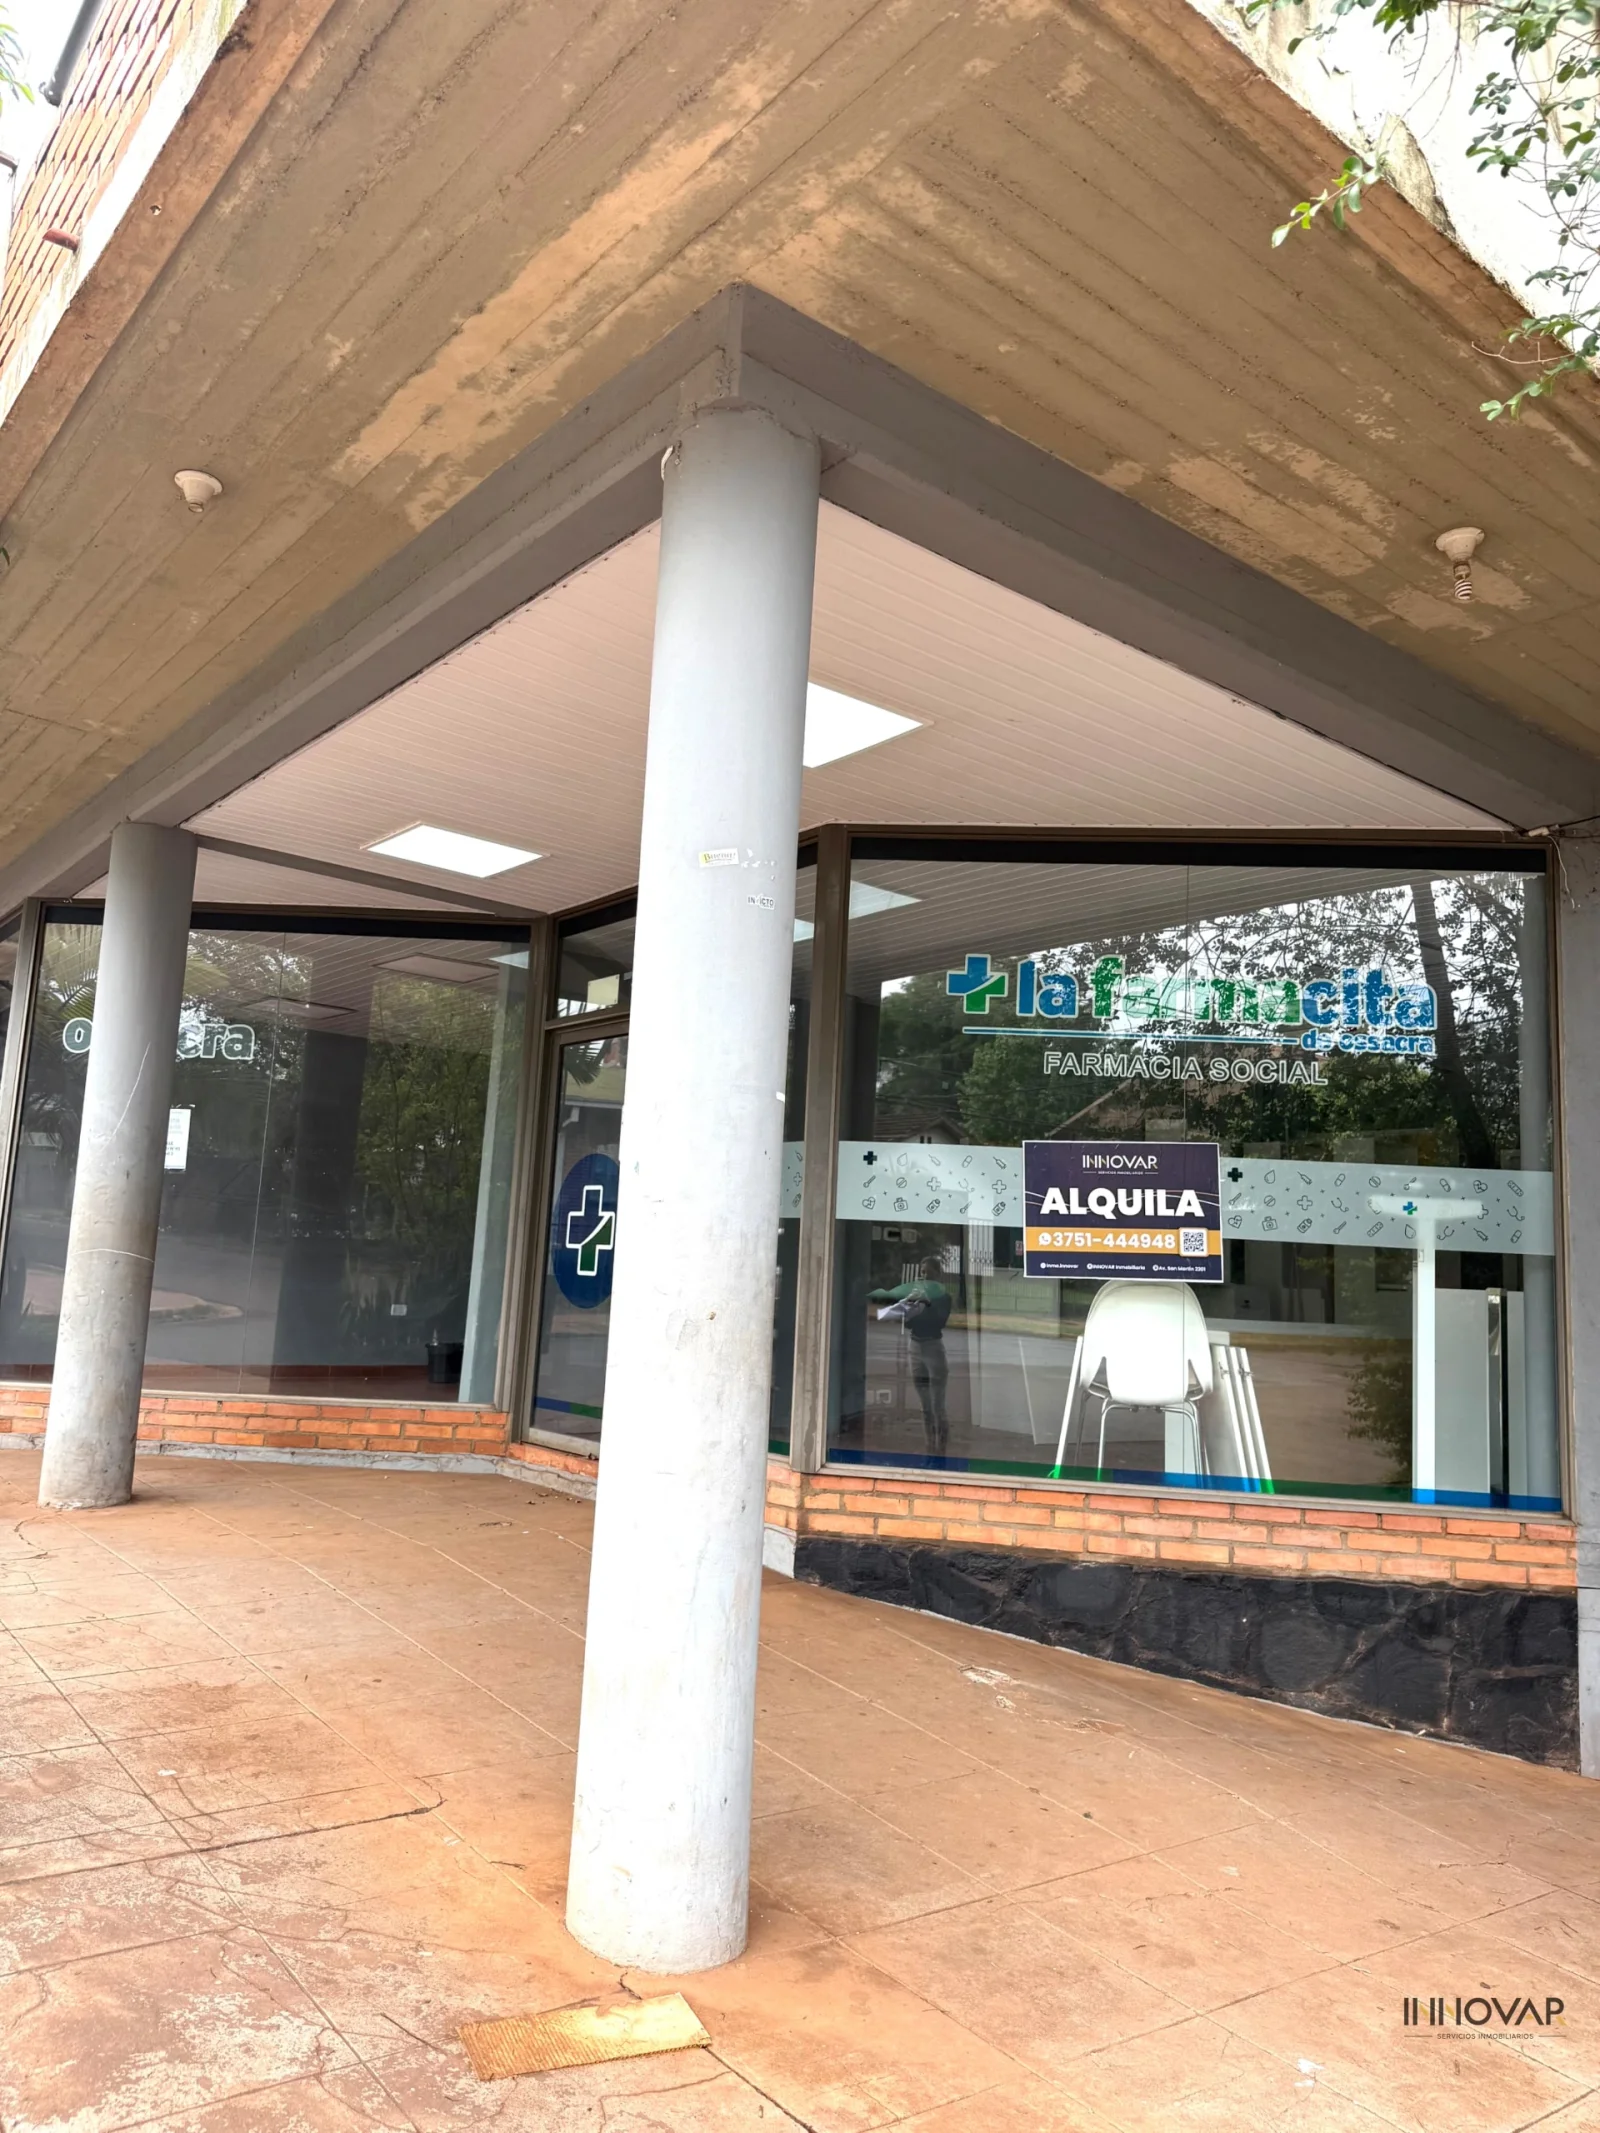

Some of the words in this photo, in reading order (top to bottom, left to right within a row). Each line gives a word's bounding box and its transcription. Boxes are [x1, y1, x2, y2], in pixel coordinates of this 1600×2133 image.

[62, 1017, 256, 1060] ocra
[1301, 1028, 1334, 1052] de
[1043, 1052, 1204, 1081] FARMACIA
[1209, 1057, 1329, 1086] SOCIAL
[1082, 1154, 1159, 1169] INNOVAR
[1040, 1187, 1205, 1220] ALQUILA
[1053, 1232, 1175, 1249] 3751-444948
